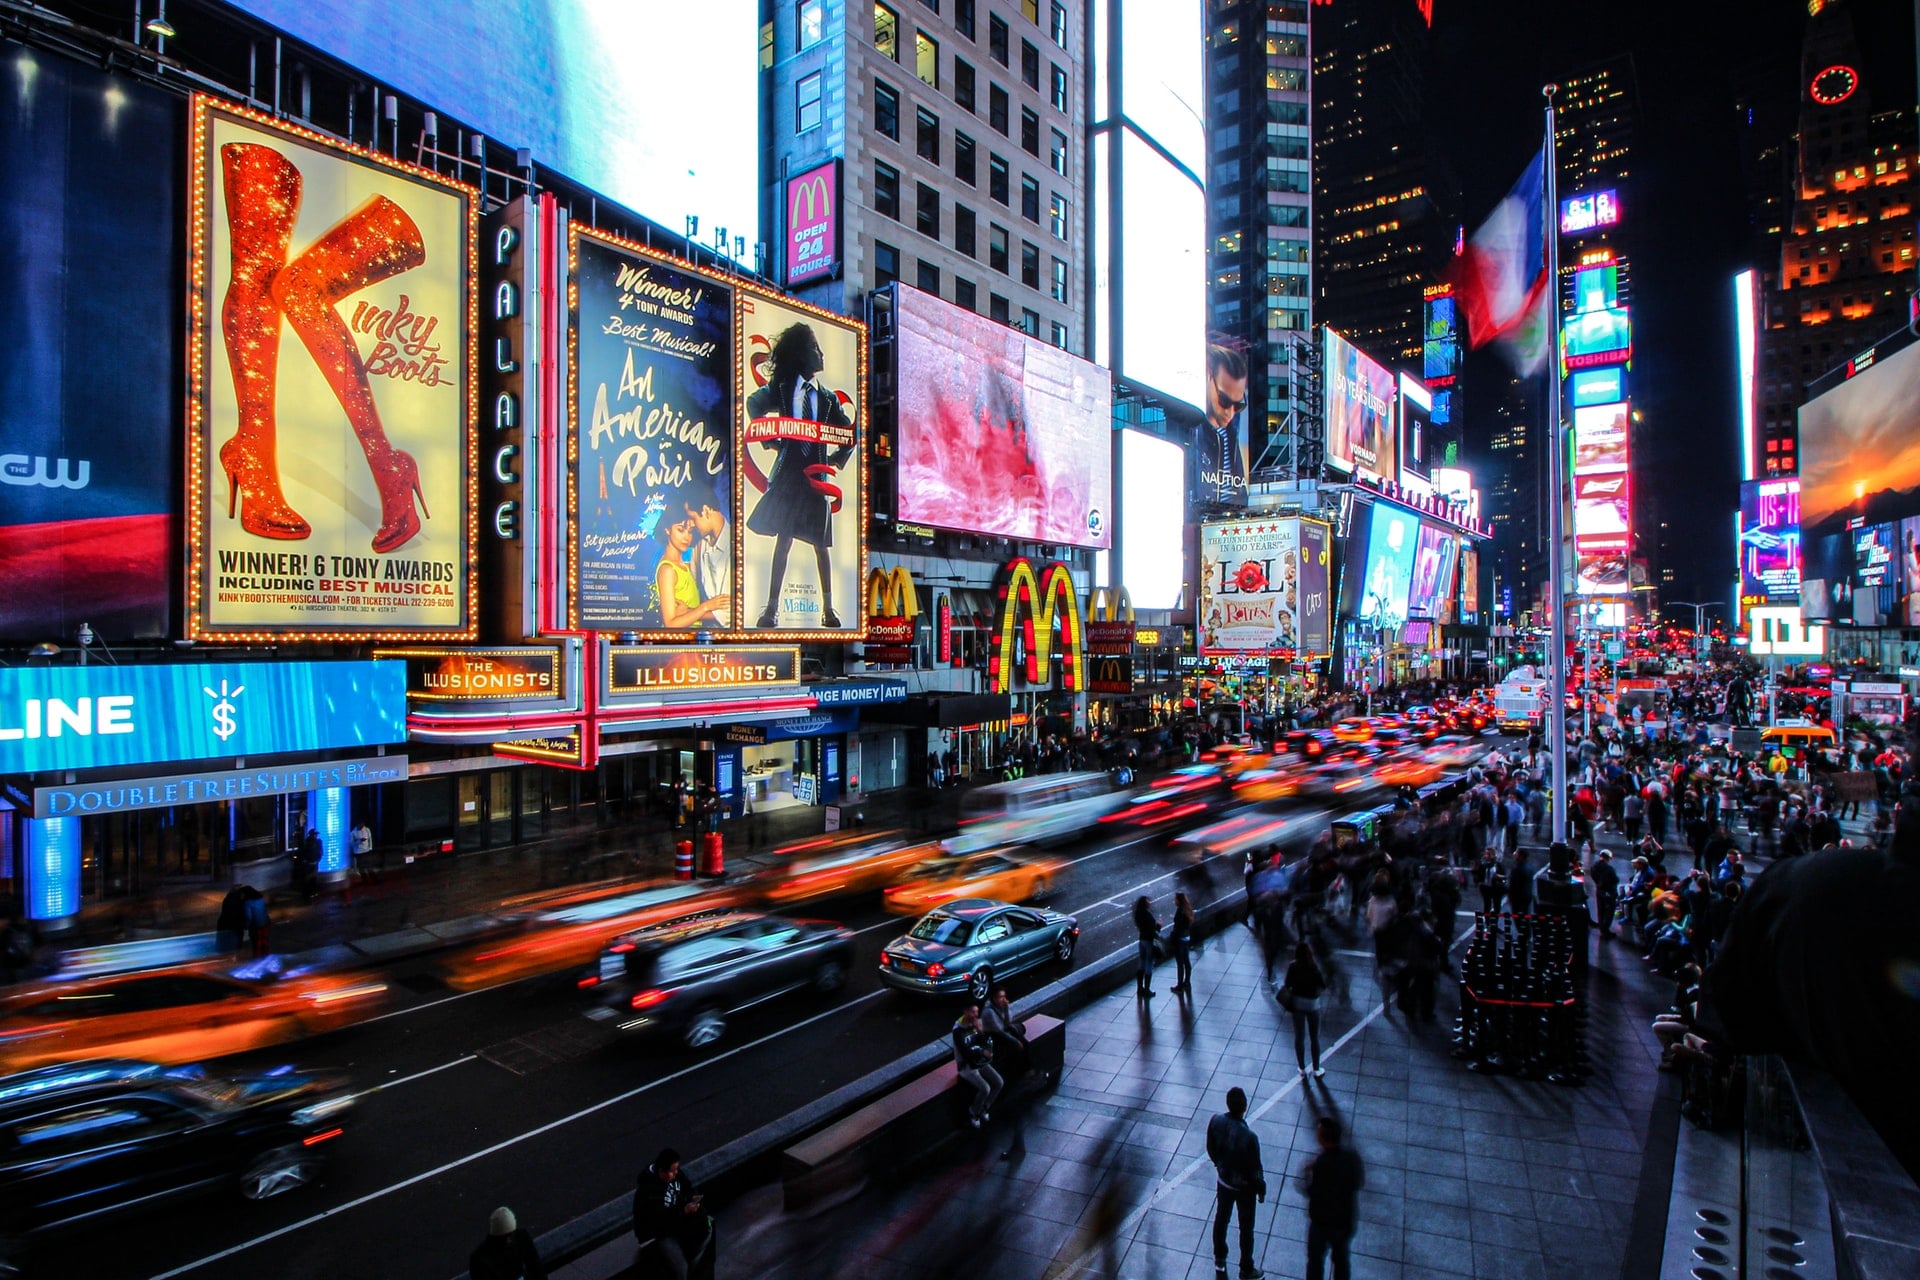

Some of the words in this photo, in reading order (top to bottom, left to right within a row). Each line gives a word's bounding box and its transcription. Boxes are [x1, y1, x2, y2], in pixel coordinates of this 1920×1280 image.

[795, 222, 827, 243] OPEN
[798, 237, 824, 261] 24
[790, 255, 831, 278] HOURS
[615, 262, 702, 311] Winner!
[618, 294, 634, 310] 4
[635, 299, 659, 316] TONY
[660, 306, 694, 326] AWARDS
[602, 316, 648, 341] Best
[651, 327, 716, 359] Musical!
[364, 342, 456, 388] Boots
[1567, 350, 1629, 368] TOSHIBA
[496, 226, 521, 540] PALACE
[617, 347, 655, 401] An
[1337, 374, 1346, 393] 50
[1348, 377, 1367, 406] YEARS
[1368, 392, 1387, 417] LISTED
[588, 382, 724, 475] American
[750, 420, 777, 437] FINAL
[779, 420, 817, 438] MONTHS
[659, 437, 672, 449] in
[9, 466, 28, 474] THE
[612, 445, 692, 496] Paris
[1201, 470, 1248, 488] NAUTICA
[219, 551, 307, 576] WINNER!
[314, 556, 325, 577] 6
[331, 556, 379, 579] TONY
[384, 560, 454, 582] AWARDS
[219, 577, 314, 591] INCLUDING
[319, 579, 369, 593] BEST
[374, 582, 454, 596] MUSICAL
[218, 593, 340, 605] KINKYBOOTSTHEMUSICAL.COM
[346, 596, 361, 605] FOR
[362, 597, 392, 607] TICKETS
[392, 598, 409, 607] CALL
[411, 598, 454, 608] 212-239-6200
[783, 598, 819, 613] Matilda
[1306, 592, 1322, 617] CATS
[1087, 628, 1132, 636] McDonald's
[465, 662, 493, 672] THE
[703, 653, 726, 664] THE
[1179, 656, 1210, 667] GIFS
[1217, 657, 1270, 668] LUGAGE
[423, 673, 551, 689] ILLUSIONISTS
[635, 665, 778, 686] ILLUSIONISTS
[841, 687, 880, 701] MONEY
[884, 685, 906, 698] ATM
[726, 733, 765, 744] EXCHANGE
[731, 725, 758, 734] MONEY
[346, 763, 368, 774] BY
[346, 769, 400, 783] HILTON
